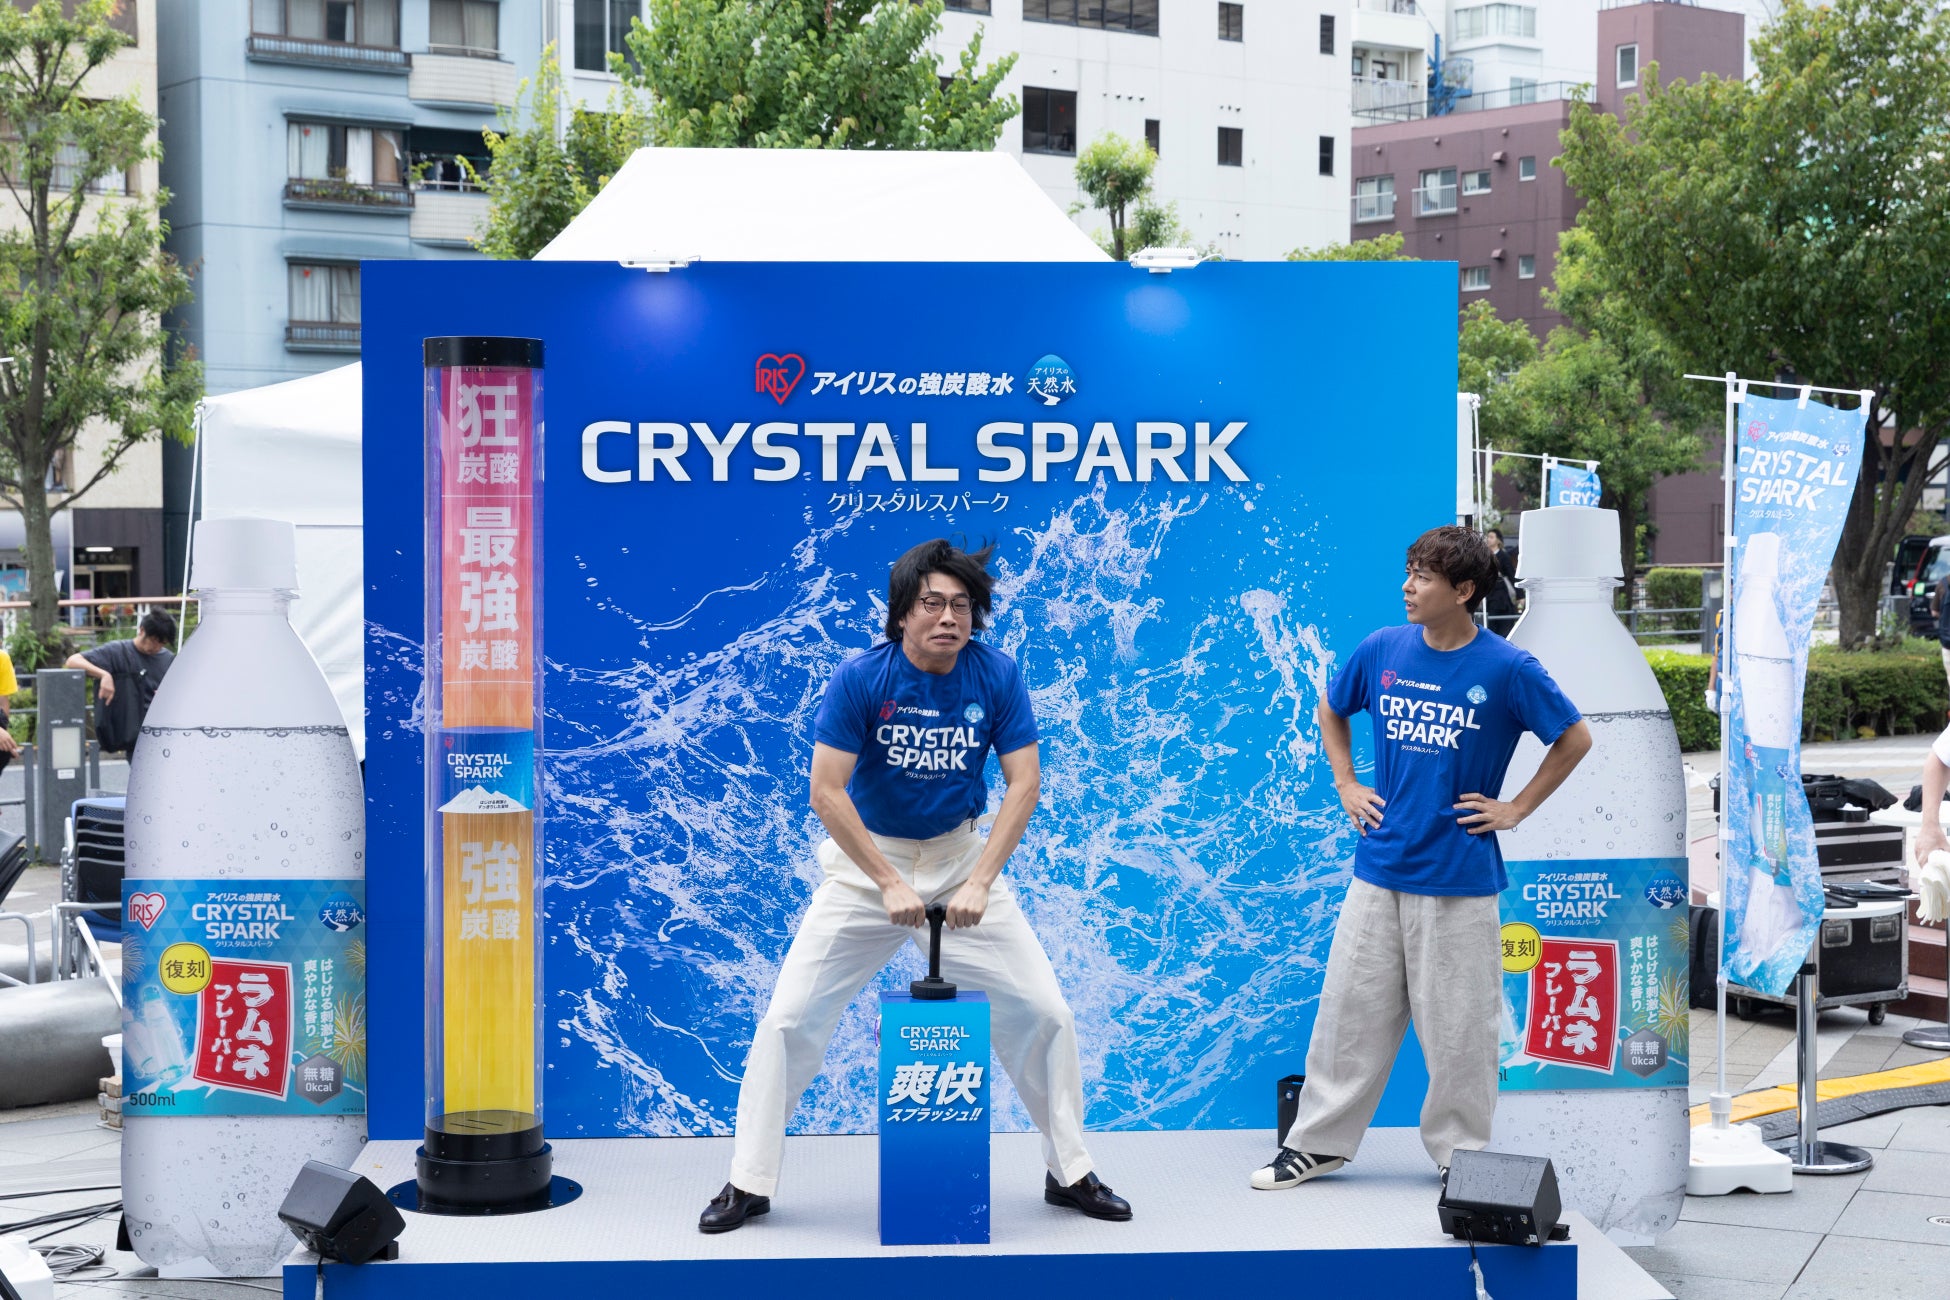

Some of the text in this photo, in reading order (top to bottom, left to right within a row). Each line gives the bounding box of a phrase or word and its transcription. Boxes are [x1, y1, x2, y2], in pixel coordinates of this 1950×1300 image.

[756, 368, 790, 392] IRIS
[1034, 366, 1069, 376] アイリスの
[810, 372, 1014, 396] アイリスの強炭酸水
[1026, 378, 1077, 394] 天然水
[457, 383, 520, 448] 狂
[581, 420, 1250, 483] CRYSTAL SPARK
[457, 452, 520, 484] 炭酸
[1740, 446, 1848, 486] CRYSTAL
[827, 492, 1010, 512] クリスタルスパーク
[1740, 477, 1826, 512] SPARK
[459, 507, 520, 633] 最強
[459, 640, 520, 671] 炭酸
[1380, 694, 1480, 730] CRYSTAL
[876, 724, 980, 748] CRYSTAL
[1386, 719, 1464, 750] SPARK
[448, 754, 512, 766] CRYSTAL
[886, 746, 968, 770] SPARK
[454, 766, 504, 778] SPARK
[460, 840, 521, 904] 強
[1537, 872, 1608, 882] アイリスの強炭酸水
[206, 892, 280, 902] アイリスの強炭酸水
[1523, 884, 1622, 900] CRYSTAL
[1647, 887, 1686, 900] 天然水
[129, 904, 154, 920] IRIS
[192, 904, 294, 920] CRYSTAL
[322, 909, 361, 922] 天然水
[1536, 902, 1608, 918] SPARK
[206, 922, 280, 940] SPARK
[460, 909, 520, 940] 炭酸
[1501, 939, 1535, 957] 復刻
[165, 960, 205, 978] 復刻
[1630, 936, 1644, 1012] 爽やかな香り
[1646, 935, 1658, 1024] はじける刺激と
[304, 959, 317, 1037] 爽やかな香り
[321, 958, 334, 1049] はじける刺激と
[1542, 962, 1562, 1048] フレーバー
[1562, 950, 1602, 1055] ラムネ
[211, 984, 233, 1073] フレーバー
[232, 972, 274, 1080] ラムネ
[900, 1026, 970, 1038] CRYSTAL
[910, 1039, 960, 1050] SPARK
[1630, 1041, 1659, 1055] 無糖
[1632, 1056, 1658, 1066] 0kcal
[304, 1067, 334, 1082] 無糖
[886, 1061, 984, 1106] 爽快
[305, 1082, 332, 1092] 0kcal
[129, 1093, 176, 1106] 500ml
[886, 1108, 984, 1122] スプラッシュ!!
